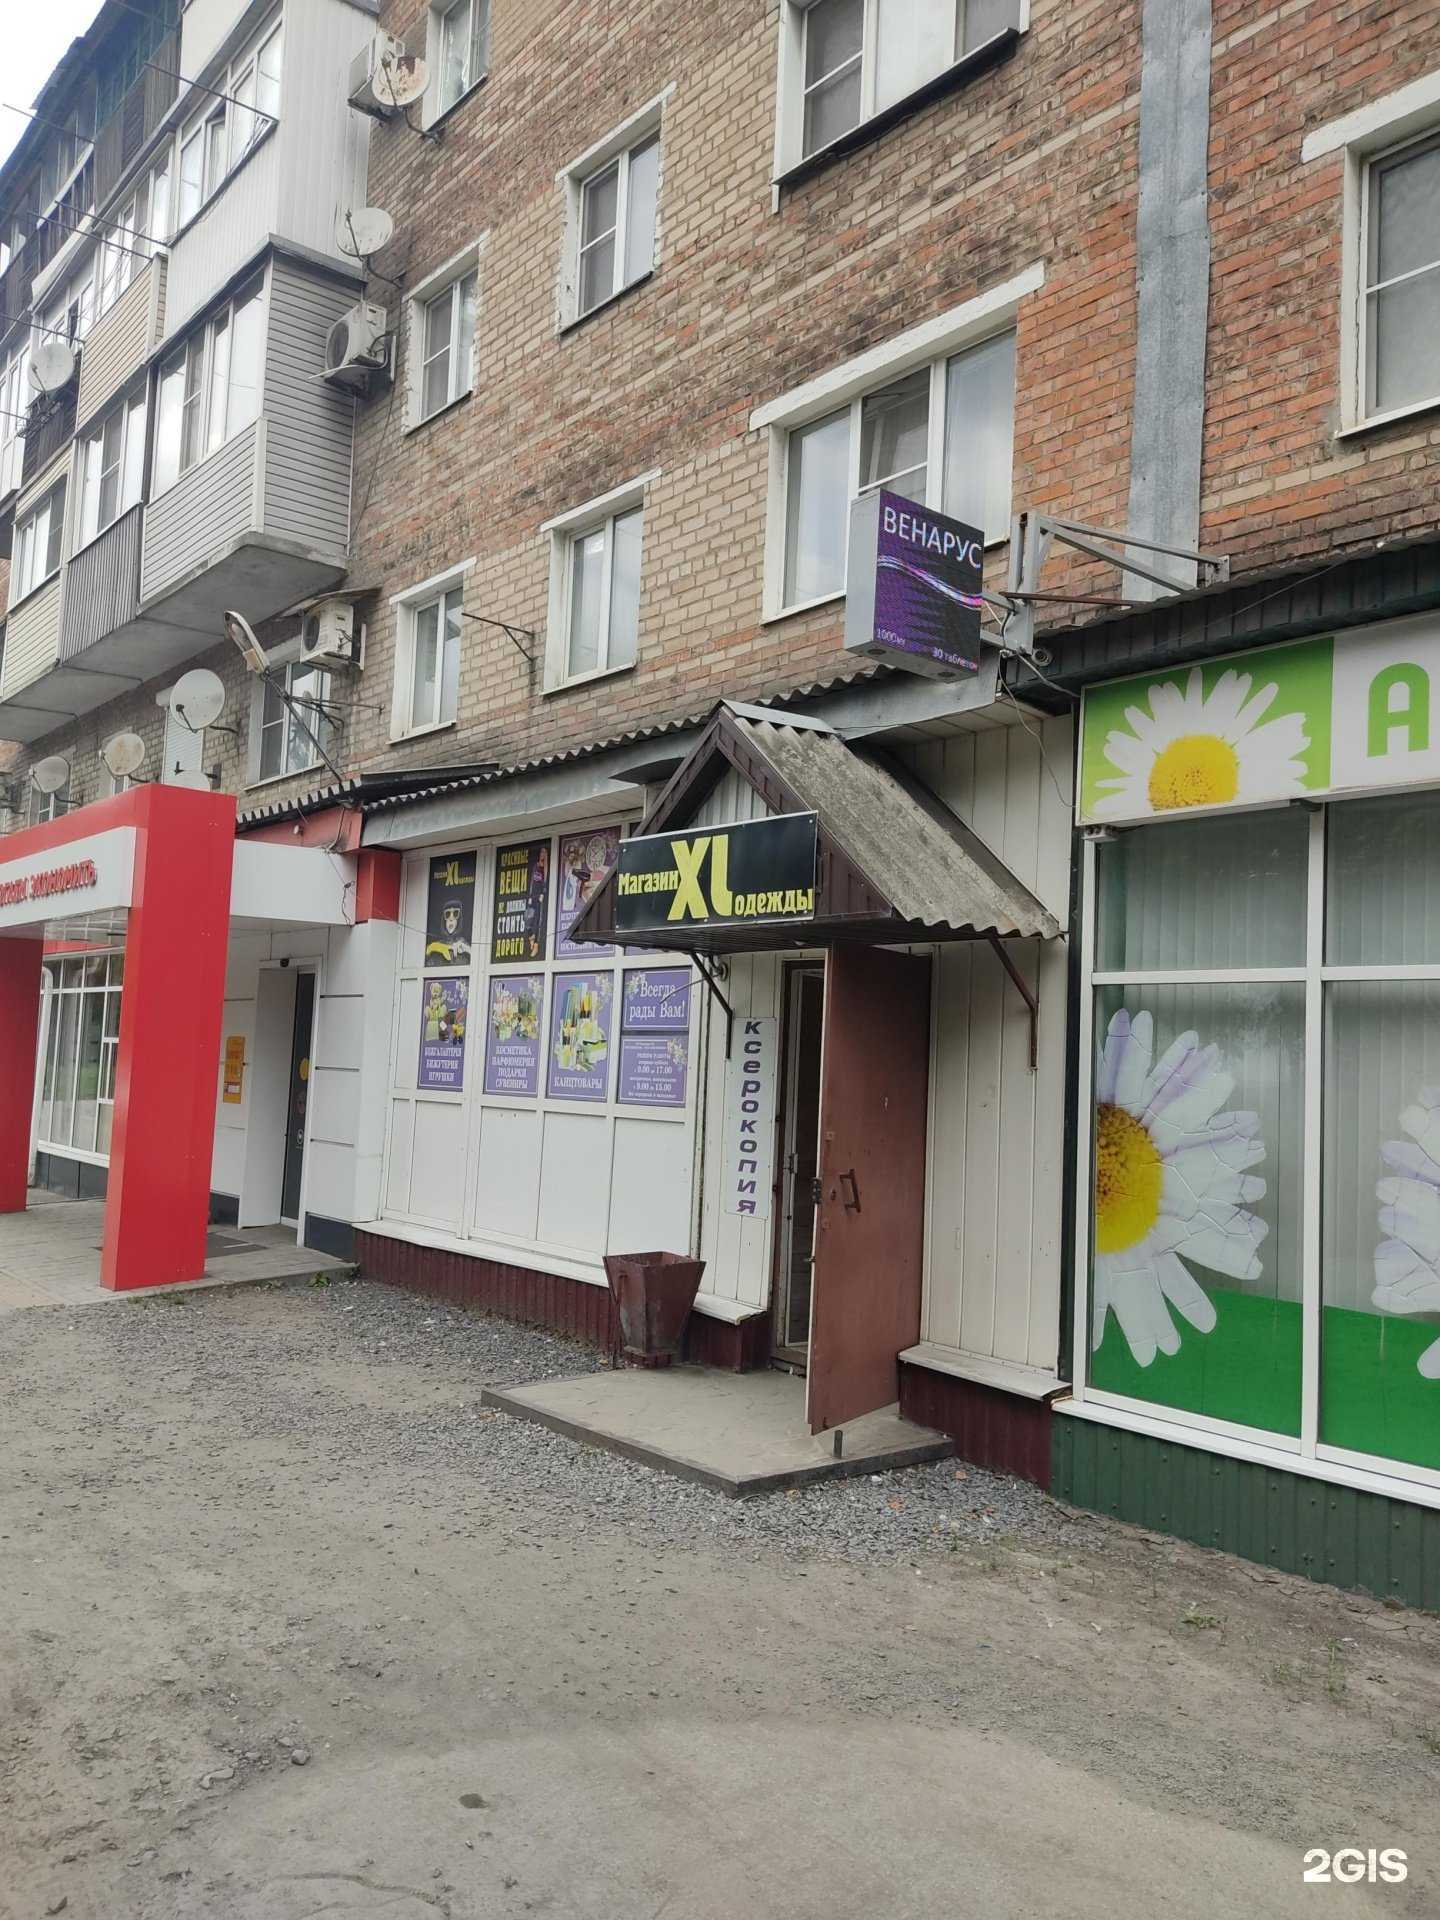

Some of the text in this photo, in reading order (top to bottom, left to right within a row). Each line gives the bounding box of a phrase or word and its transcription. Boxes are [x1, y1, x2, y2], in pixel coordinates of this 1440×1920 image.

[883, 506, 982, 569] ВЕНАРУС
[499, 868, 528, 895] ВЕЩИ
[618, 870, 680, 896] Магазин
[667, 834, 732, 921] XL
[734, 888, 813, 917] одежды
[497, 915, 525, 934] СТОИТЬ
[496, 937, 524, 957] ДОРОГО
[639, 981, 676, 1000] Всегда
[629, 1002, 685, 1021] рады Вам!
[497, 1067, 527, 1078] ПОДАРКИ
[554, 1076, 602, 1089] КАНЦТОВАРЫ
